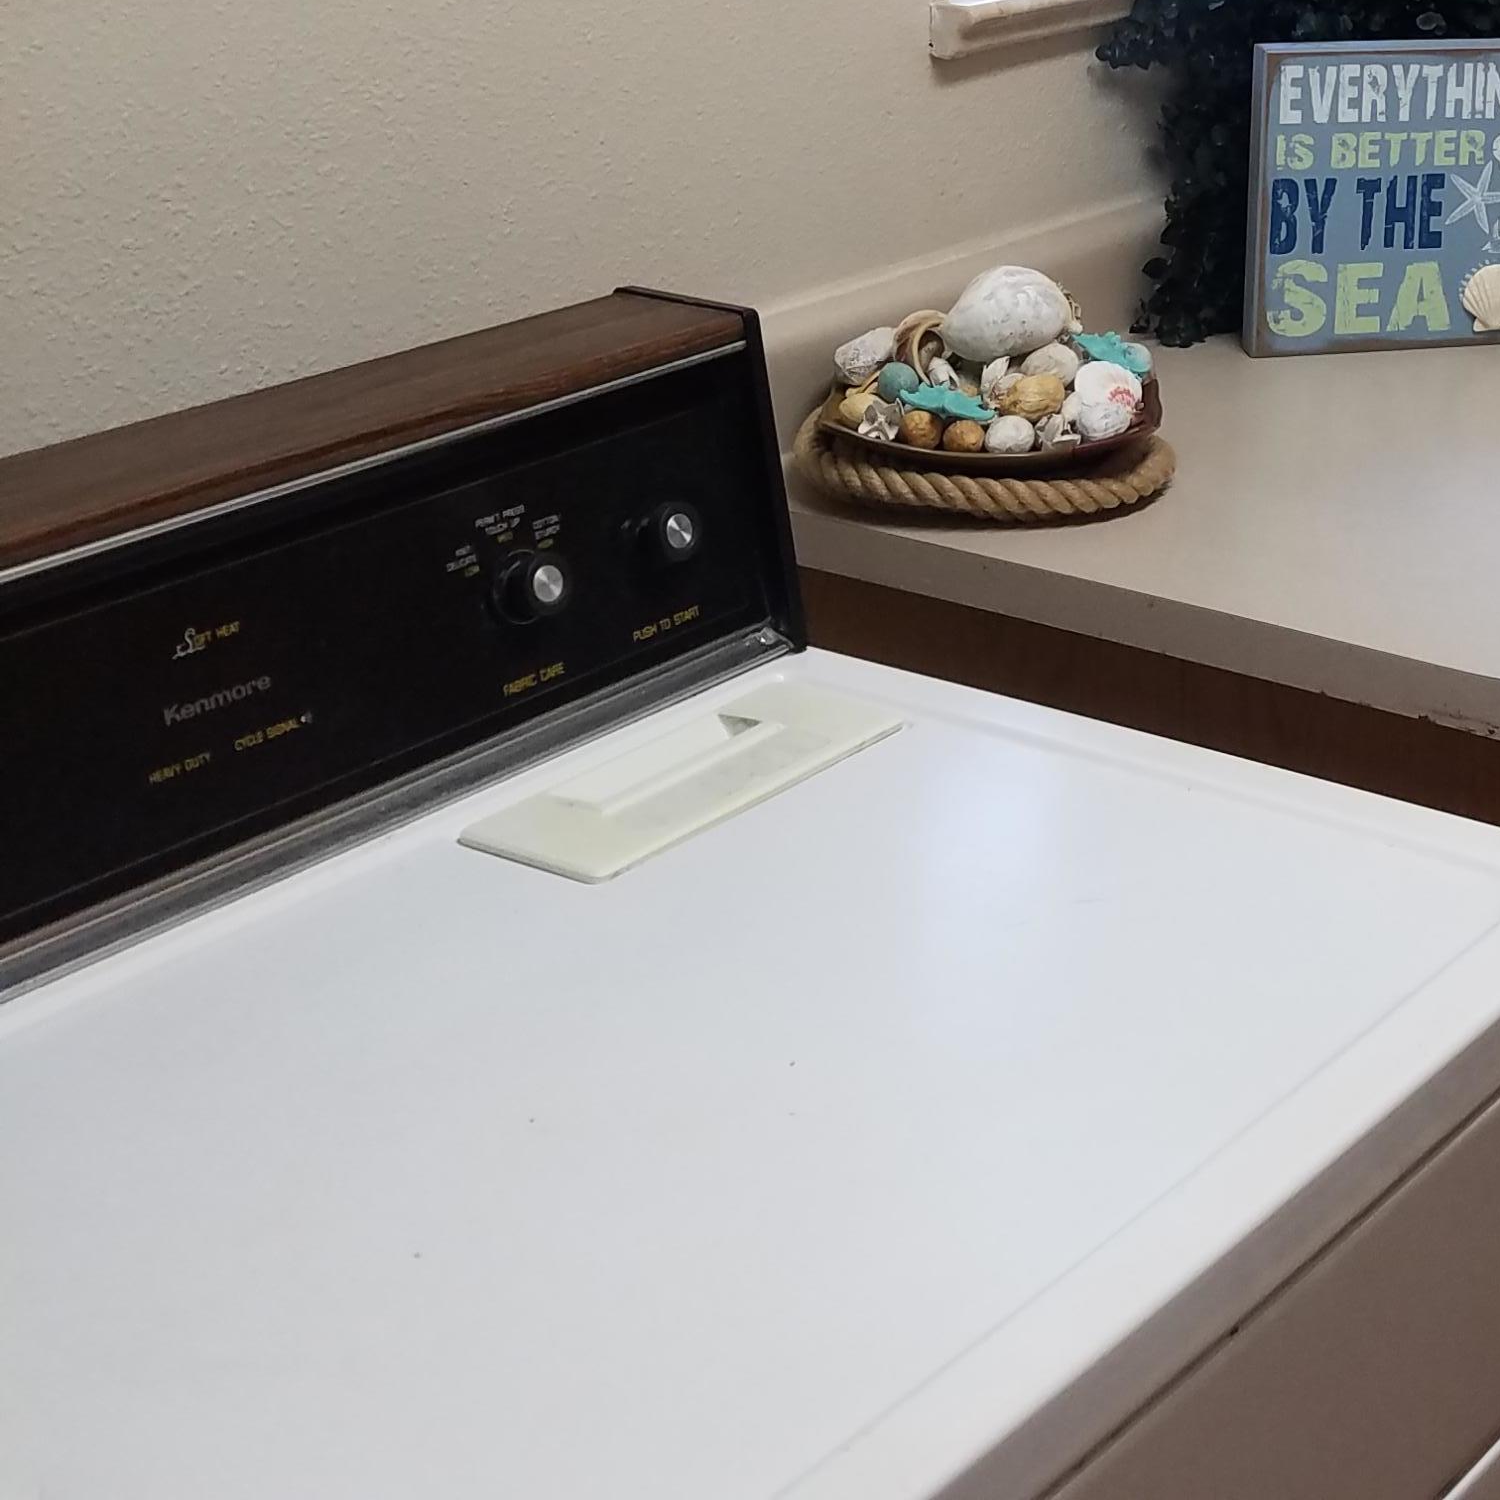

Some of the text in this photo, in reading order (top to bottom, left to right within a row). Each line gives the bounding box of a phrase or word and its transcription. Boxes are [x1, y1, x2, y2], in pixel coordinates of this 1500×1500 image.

[1275, 129, 1486, 170] IS BETTER
[1270, 173, 1446, 255] BY THE
[1266, 259, 1451, 337] SEA
[632, 623, 657, 643] PUSH
[674, 605, 700, 625] START
[163, 675, 272, 727] Kenmore
